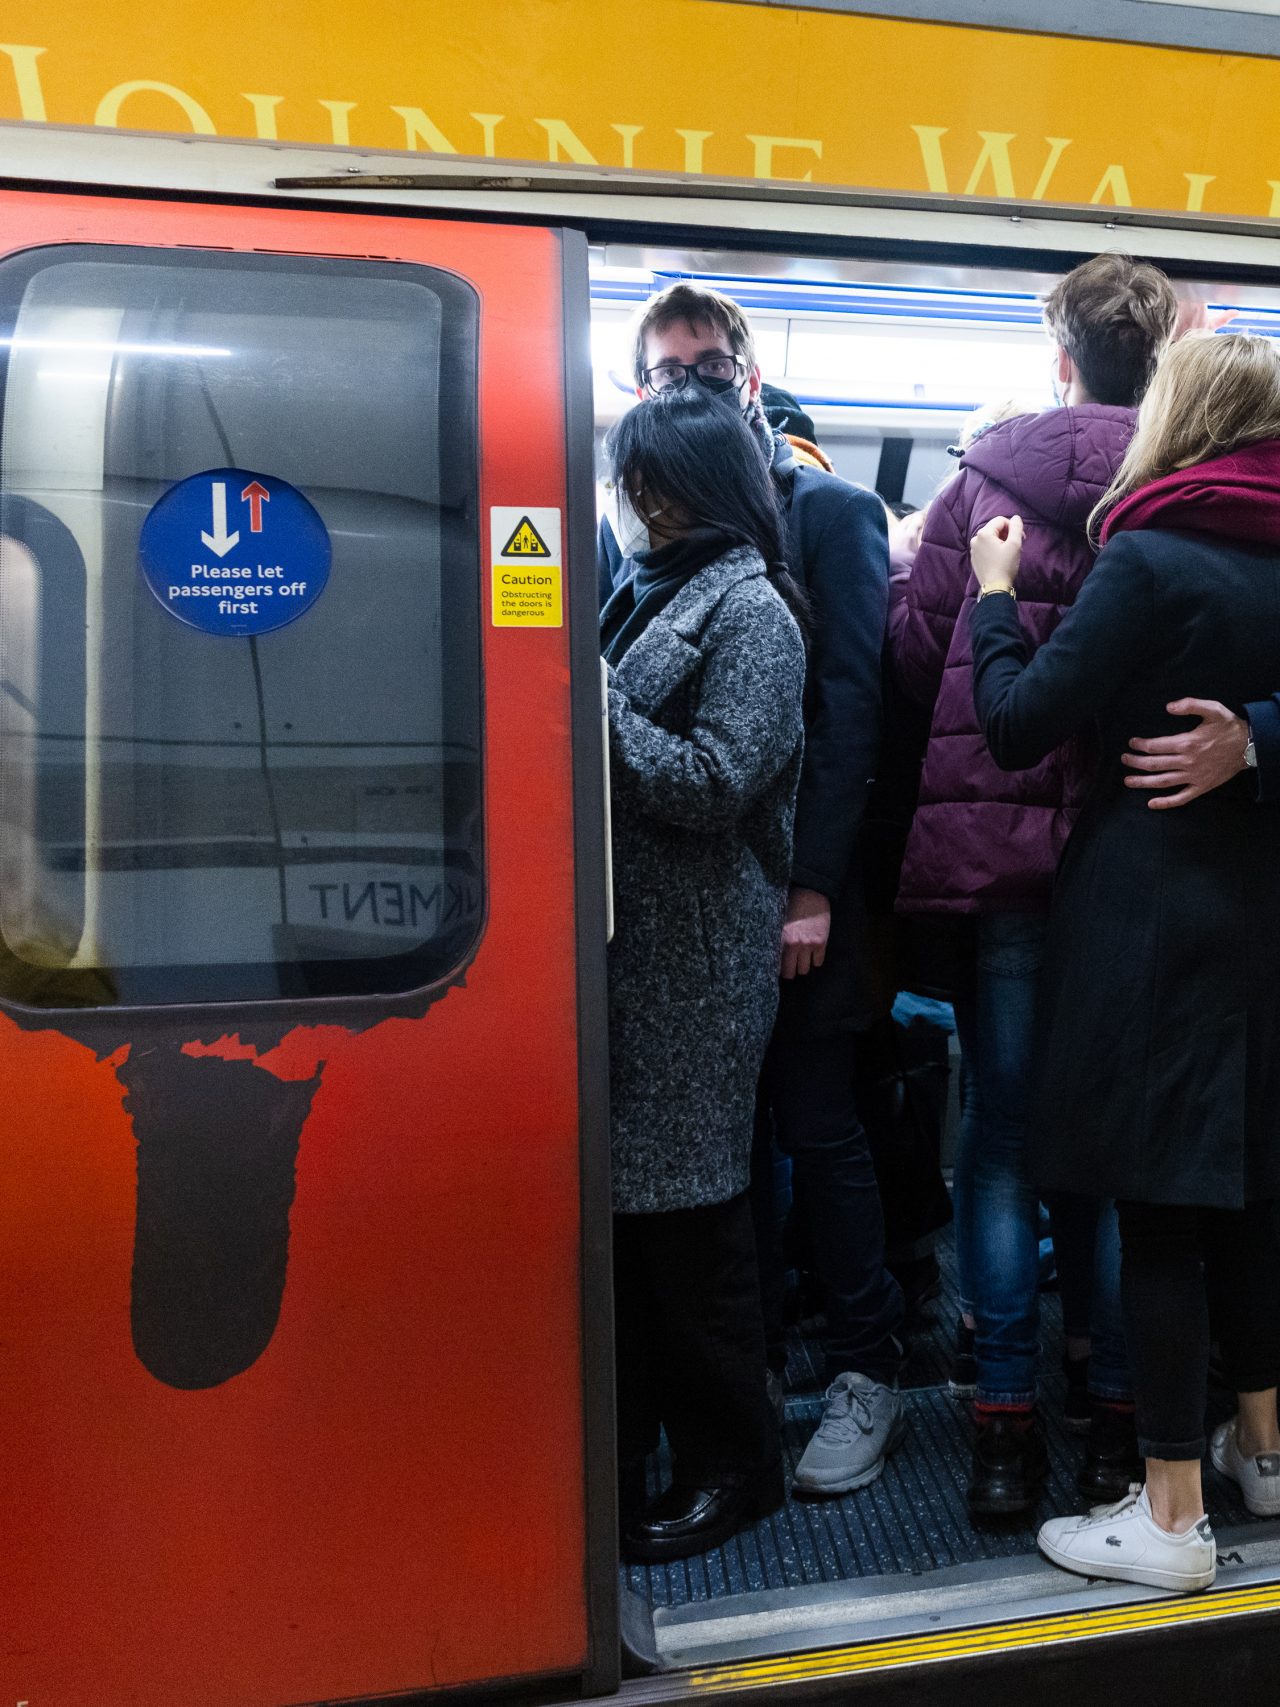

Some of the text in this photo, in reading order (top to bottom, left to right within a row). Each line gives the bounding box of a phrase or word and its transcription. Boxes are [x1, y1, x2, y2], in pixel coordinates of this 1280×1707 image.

[191, 564, 284, 579] Please let
[501, 574, 552, 584] Caution
[168, 582, 307, 600] passengers off
[501, 591, 552, 599] Obstructing
[218, 601, 259, 615] first
[545, 600, 553, 608] is
[501, 609, 544, 617] dangerous
